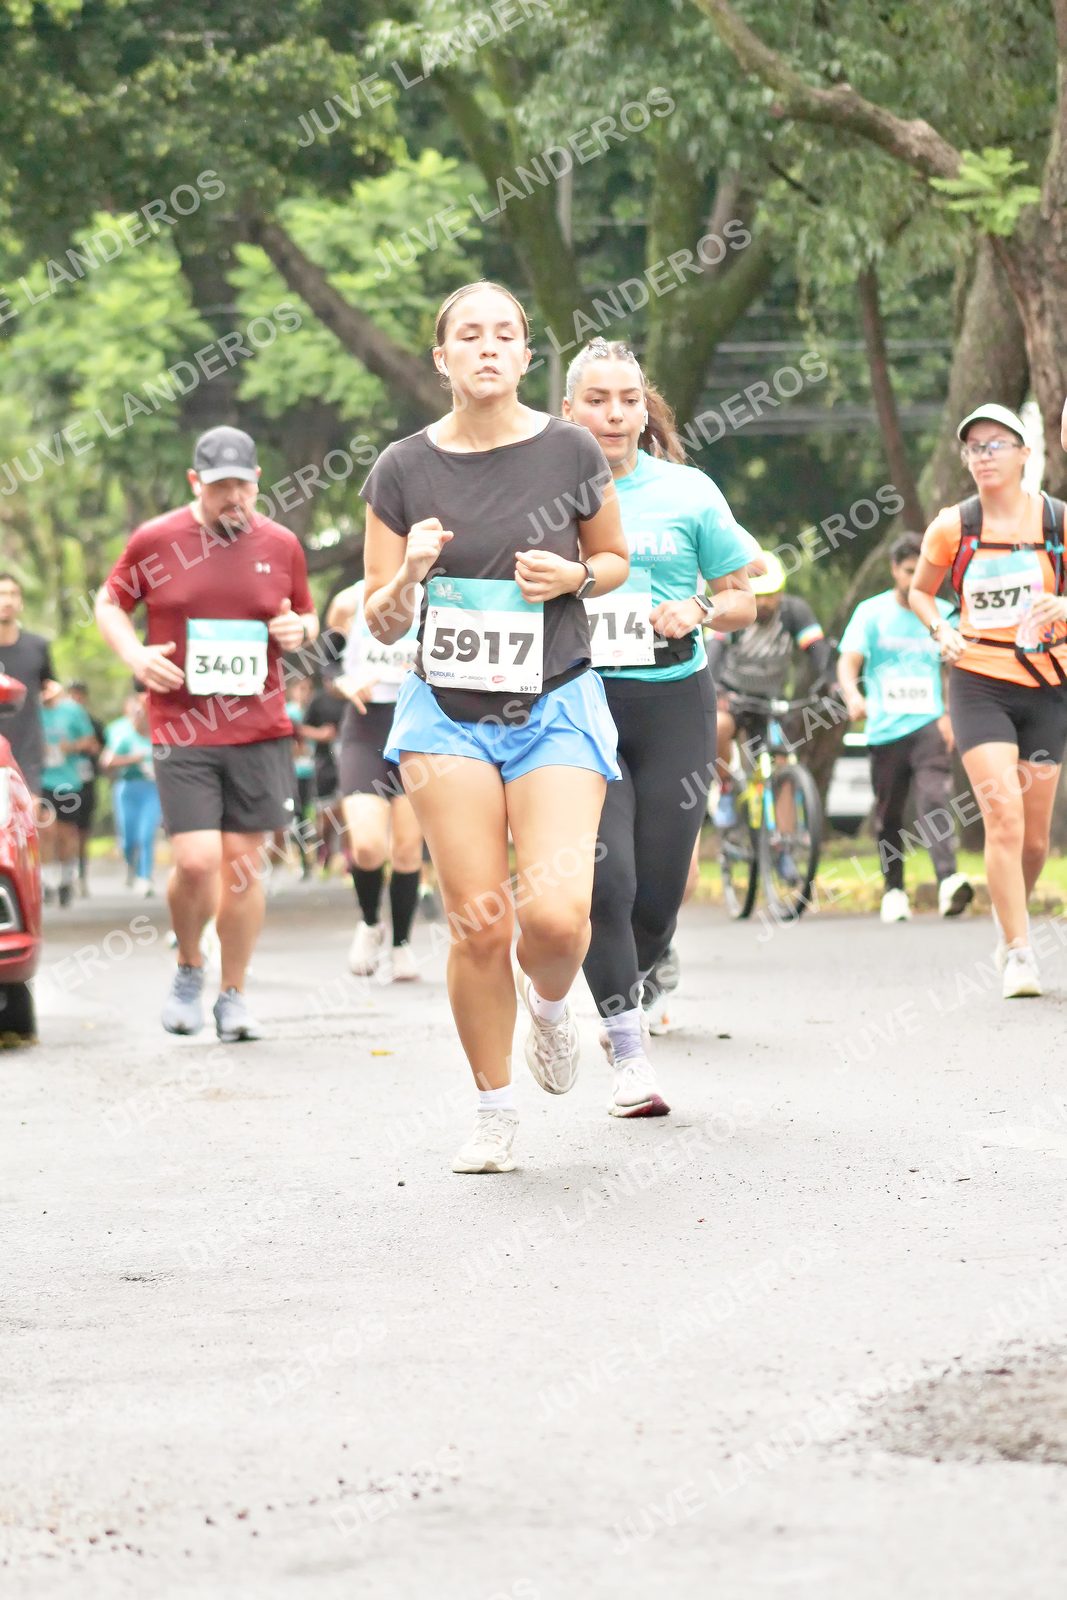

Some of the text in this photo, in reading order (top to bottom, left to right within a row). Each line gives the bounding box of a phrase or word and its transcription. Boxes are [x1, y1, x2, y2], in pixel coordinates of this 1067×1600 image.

[629, 531, 678, 555] URA
[587, 612, 646, 640] 714
[430, 628, 534, 665] 5917
[195, 655, 259, 675] 3401
